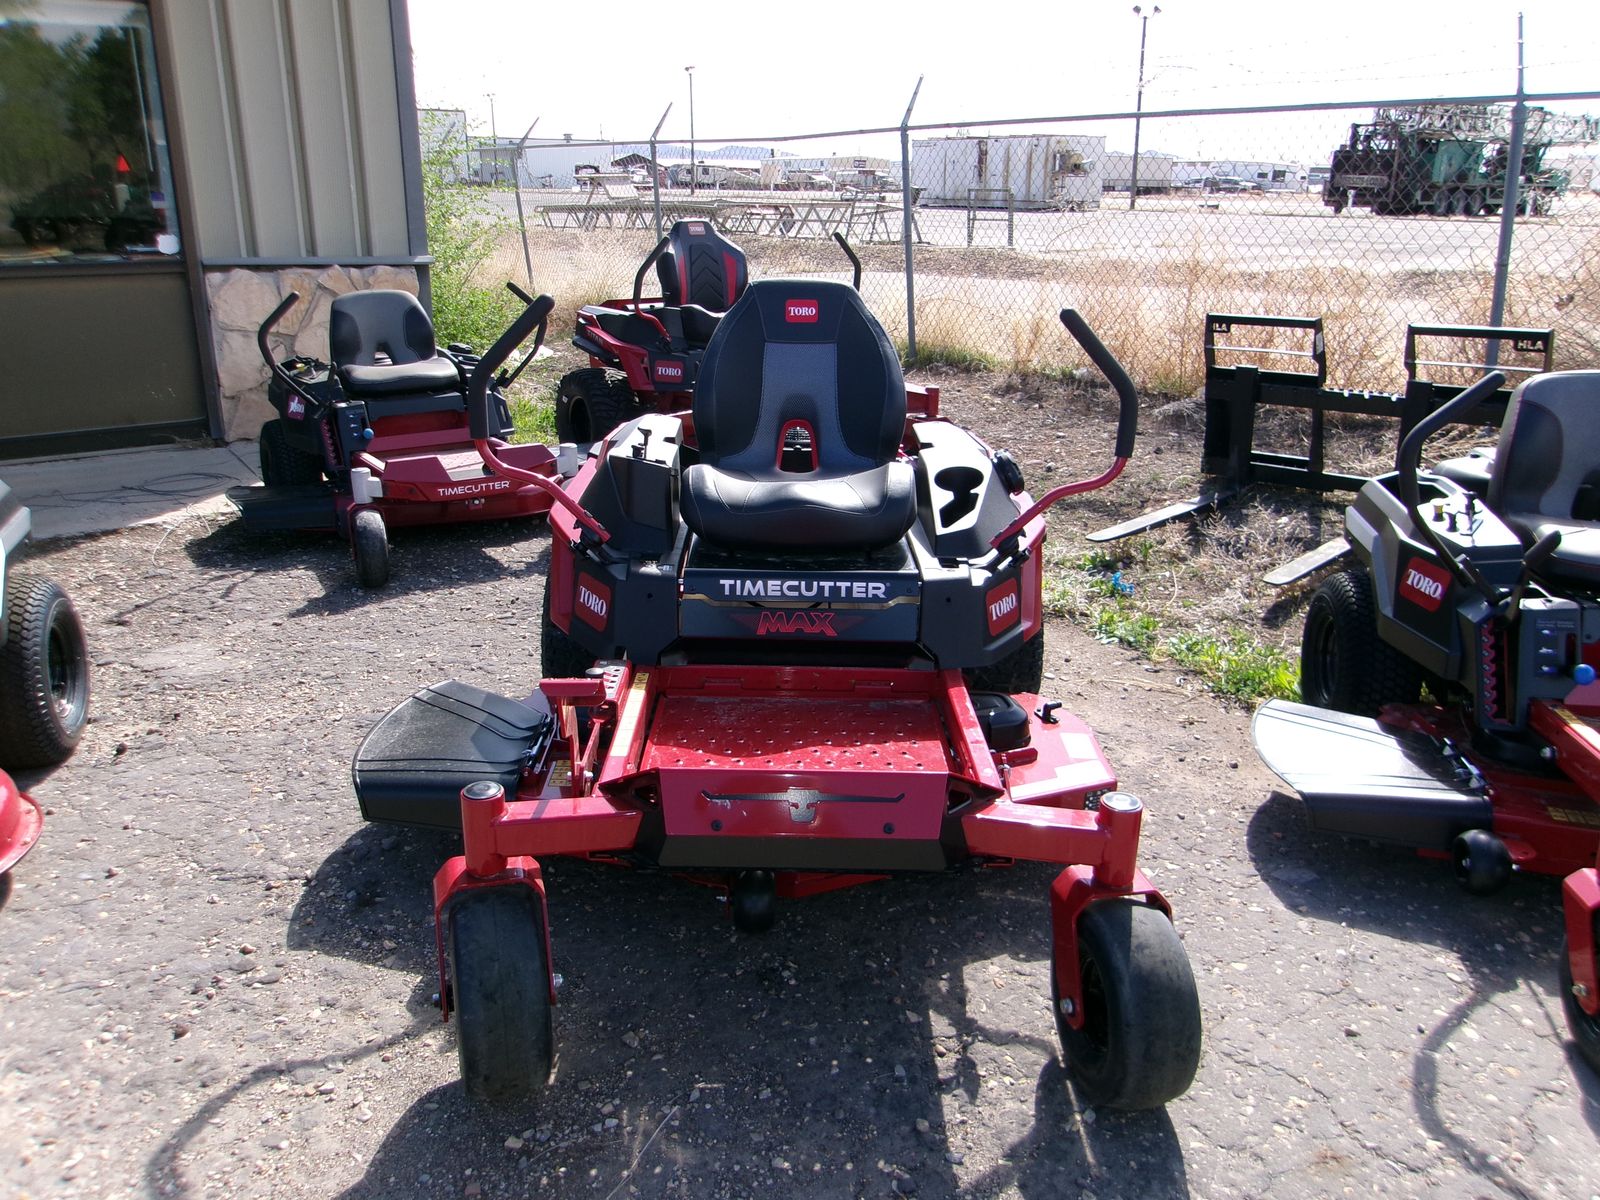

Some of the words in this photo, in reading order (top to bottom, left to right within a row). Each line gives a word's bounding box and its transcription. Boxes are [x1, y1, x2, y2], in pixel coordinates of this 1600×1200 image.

[788, 306, 816, 316] TORO
[1517, 340, 1544, 350] HLA
[657, 366, 682, 377] TORO
[437, 480, 511, 497] TIMECUTTER
[719, 579, 888, 599] TIMECUTTER
[1406, 568, 1442, 599] TORO
[579, 585, 607, 617] TORO
[989, 592, 1016, 622] TORO
[756, 611, 838, 637] MAX
